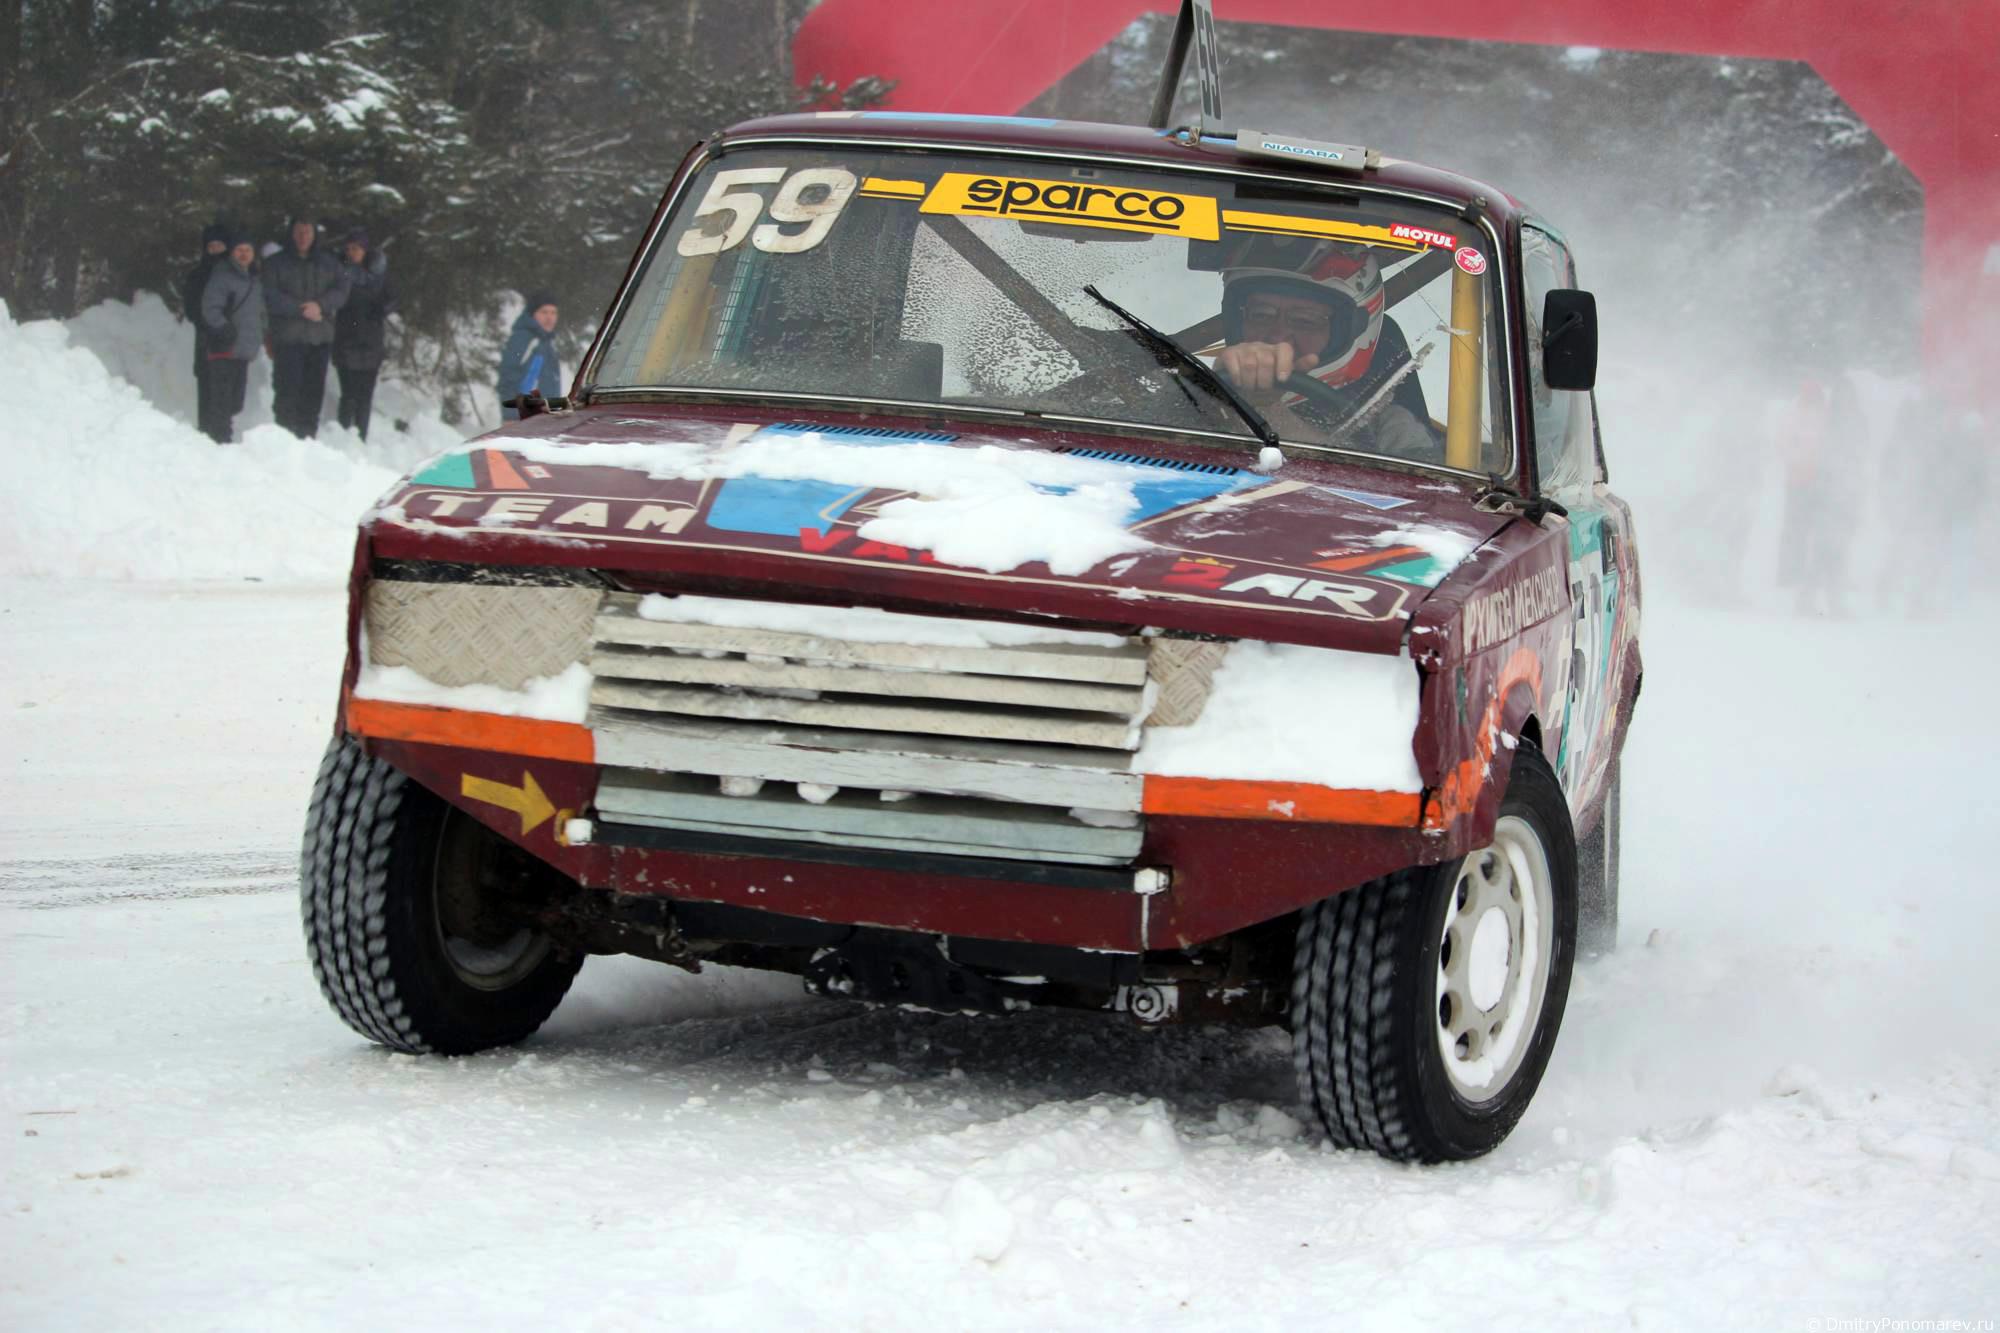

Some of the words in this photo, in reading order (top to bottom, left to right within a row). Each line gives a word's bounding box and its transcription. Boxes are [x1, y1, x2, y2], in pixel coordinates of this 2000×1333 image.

[1263, 143, 1339, 160] NIAGARA
[677, 167, 858, 257] 59
[967, 178, 1185, 221] sparco
[1393, 226, 1453, 248] MOTUL
[426, 494, 698, 534] TEAM
